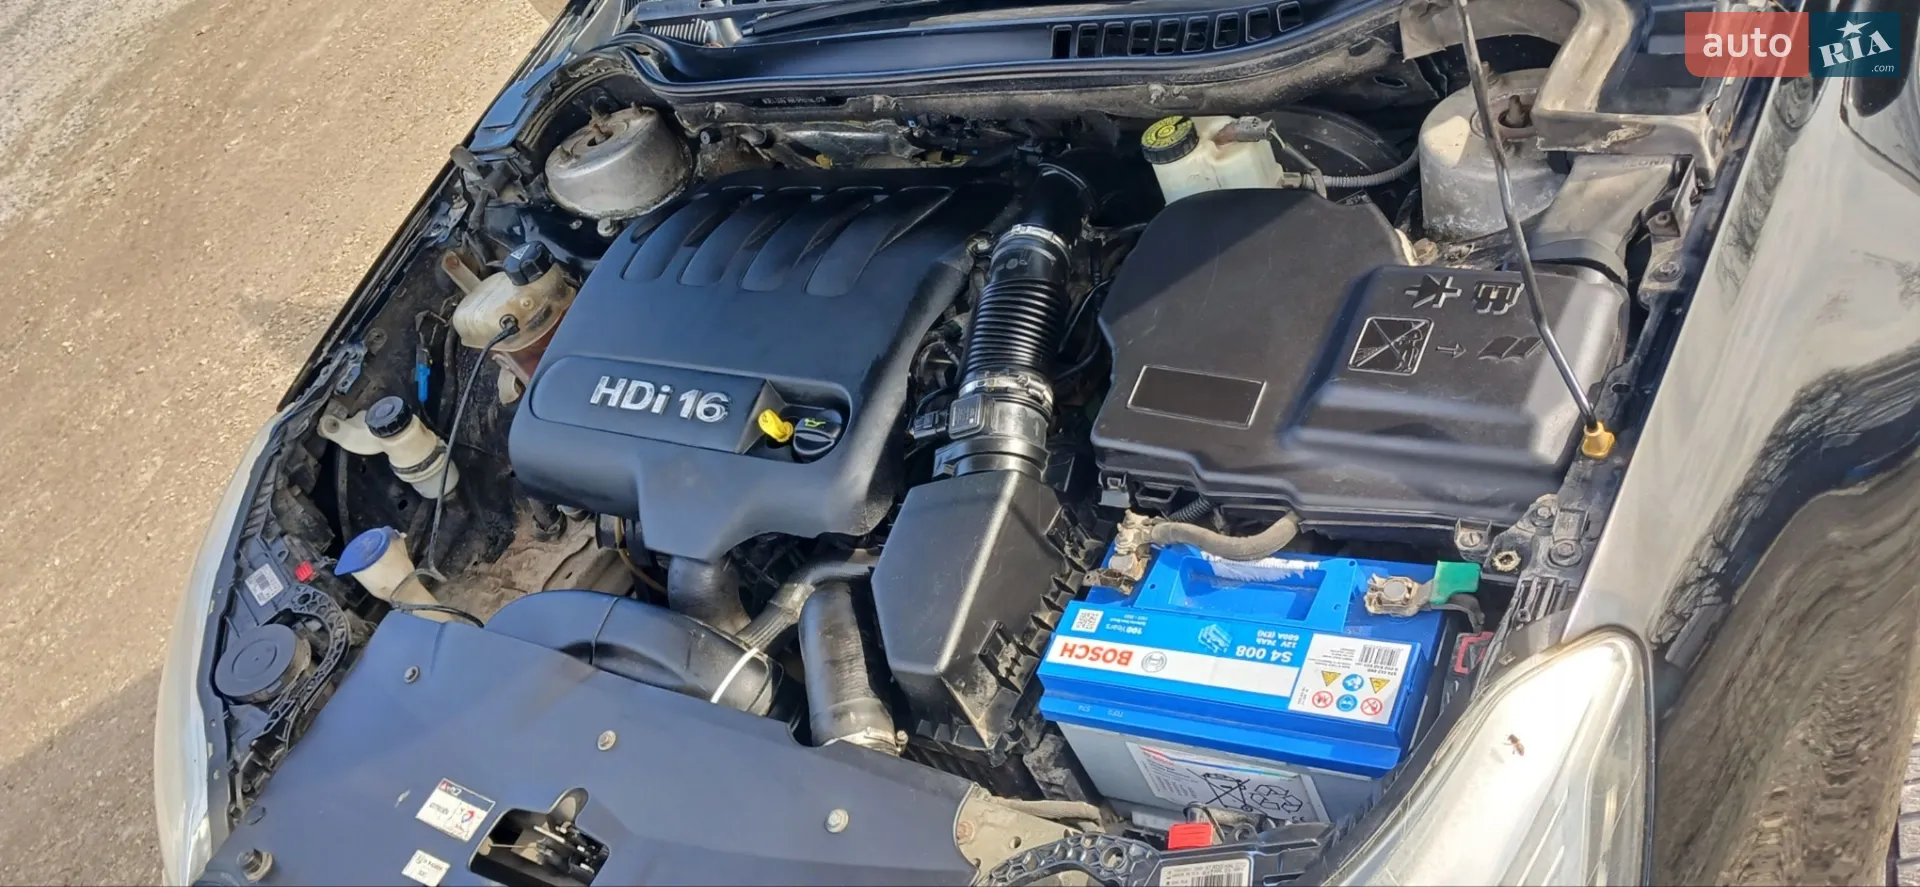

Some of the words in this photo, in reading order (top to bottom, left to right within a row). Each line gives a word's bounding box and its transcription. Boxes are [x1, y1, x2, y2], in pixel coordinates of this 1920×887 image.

[590, 375, 672, 415] HDi
[679, 389, 730, 422] 16
[1060, 642, 1133, 666] BOSCH
[1235, 645, 1267, 659] 008
[1270, 649, 1294, 663] S4
